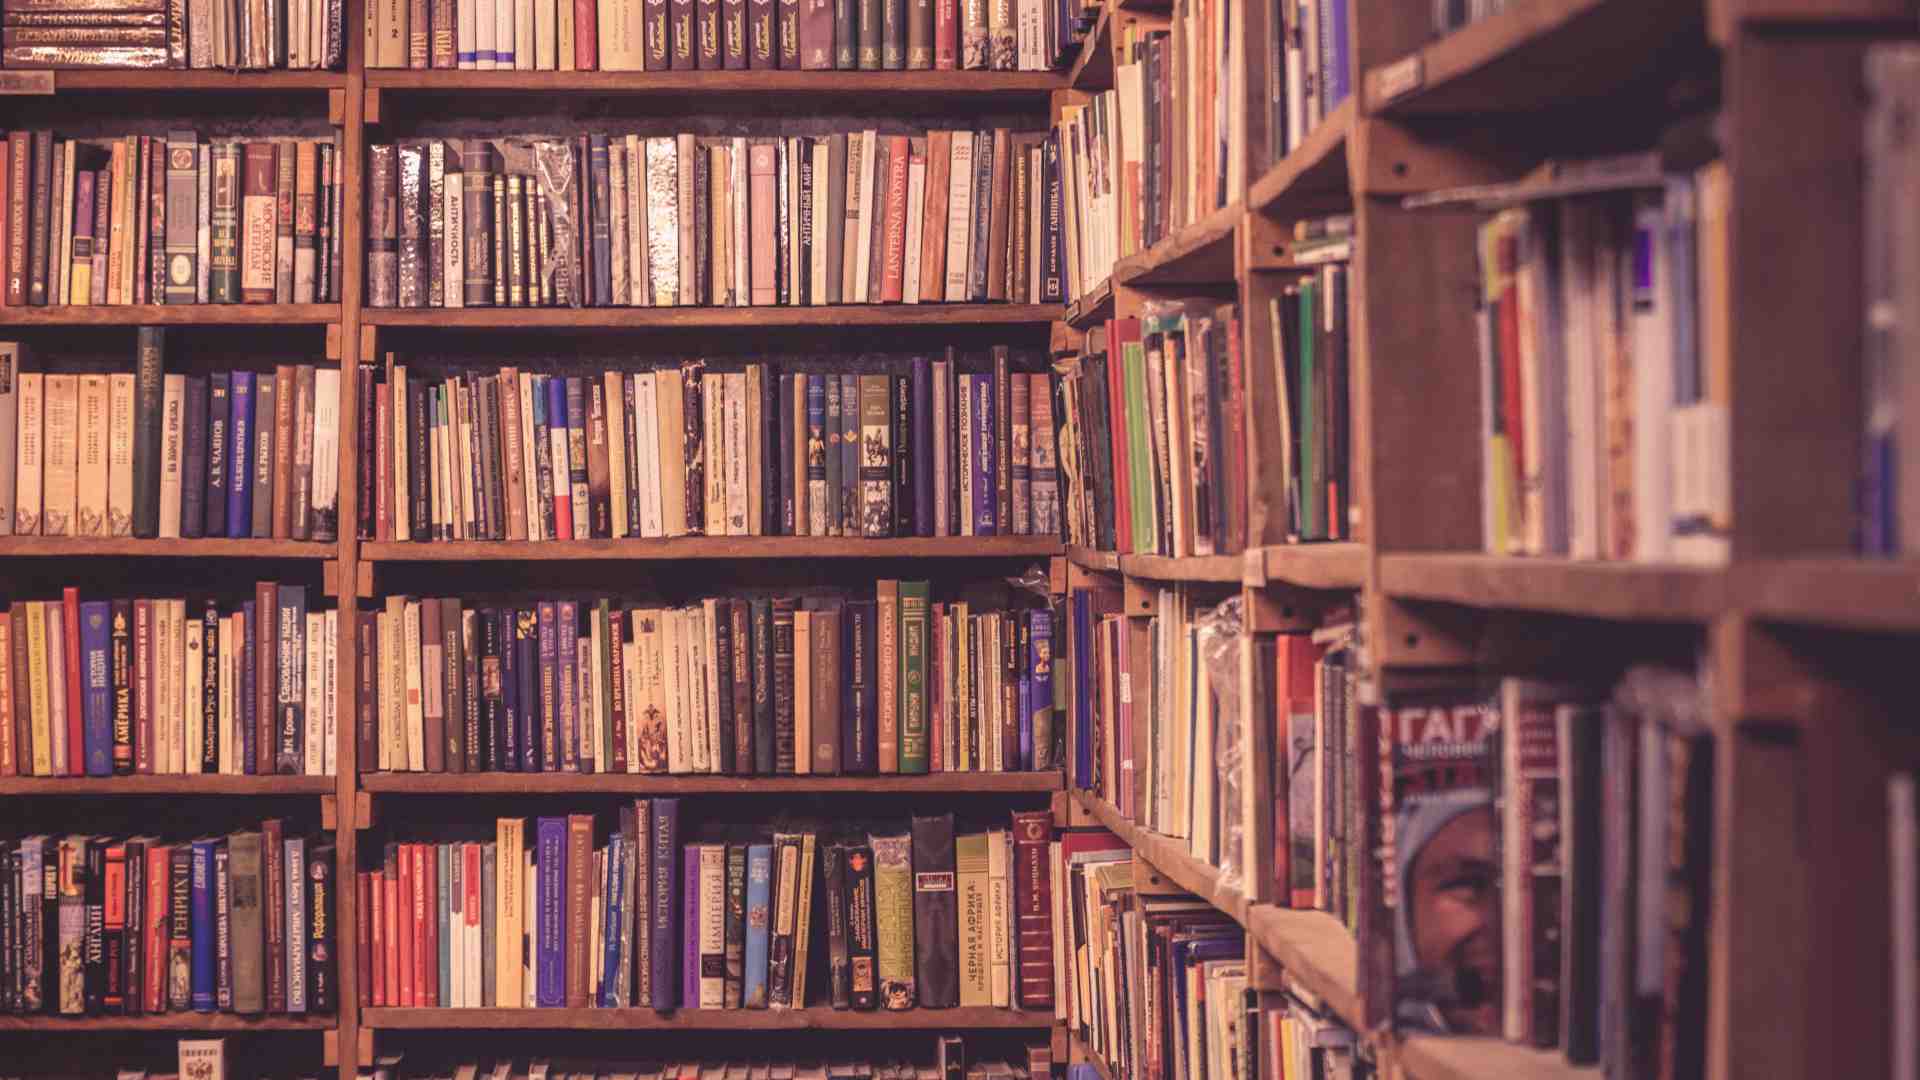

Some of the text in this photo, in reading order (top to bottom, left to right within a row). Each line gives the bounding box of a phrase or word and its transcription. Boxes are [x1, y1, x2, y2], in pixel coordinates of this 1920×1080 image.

[450, 196, 460, 266] АНТИЧНОСТЬ
[889, 155, 906, 279] LANTERNA NOSTRA
[117, 688, 130, 744] АМЕРИКА
[312, 881, 327, 939] Реформация
[656, 815, 669, 929] ИСТОРИЯ КИТАЯ
[712, 874, 722, 951] ИМПЕРИЯ
[967, 879, 977, 983] ЧЕРНАЯ АФРИКА:
